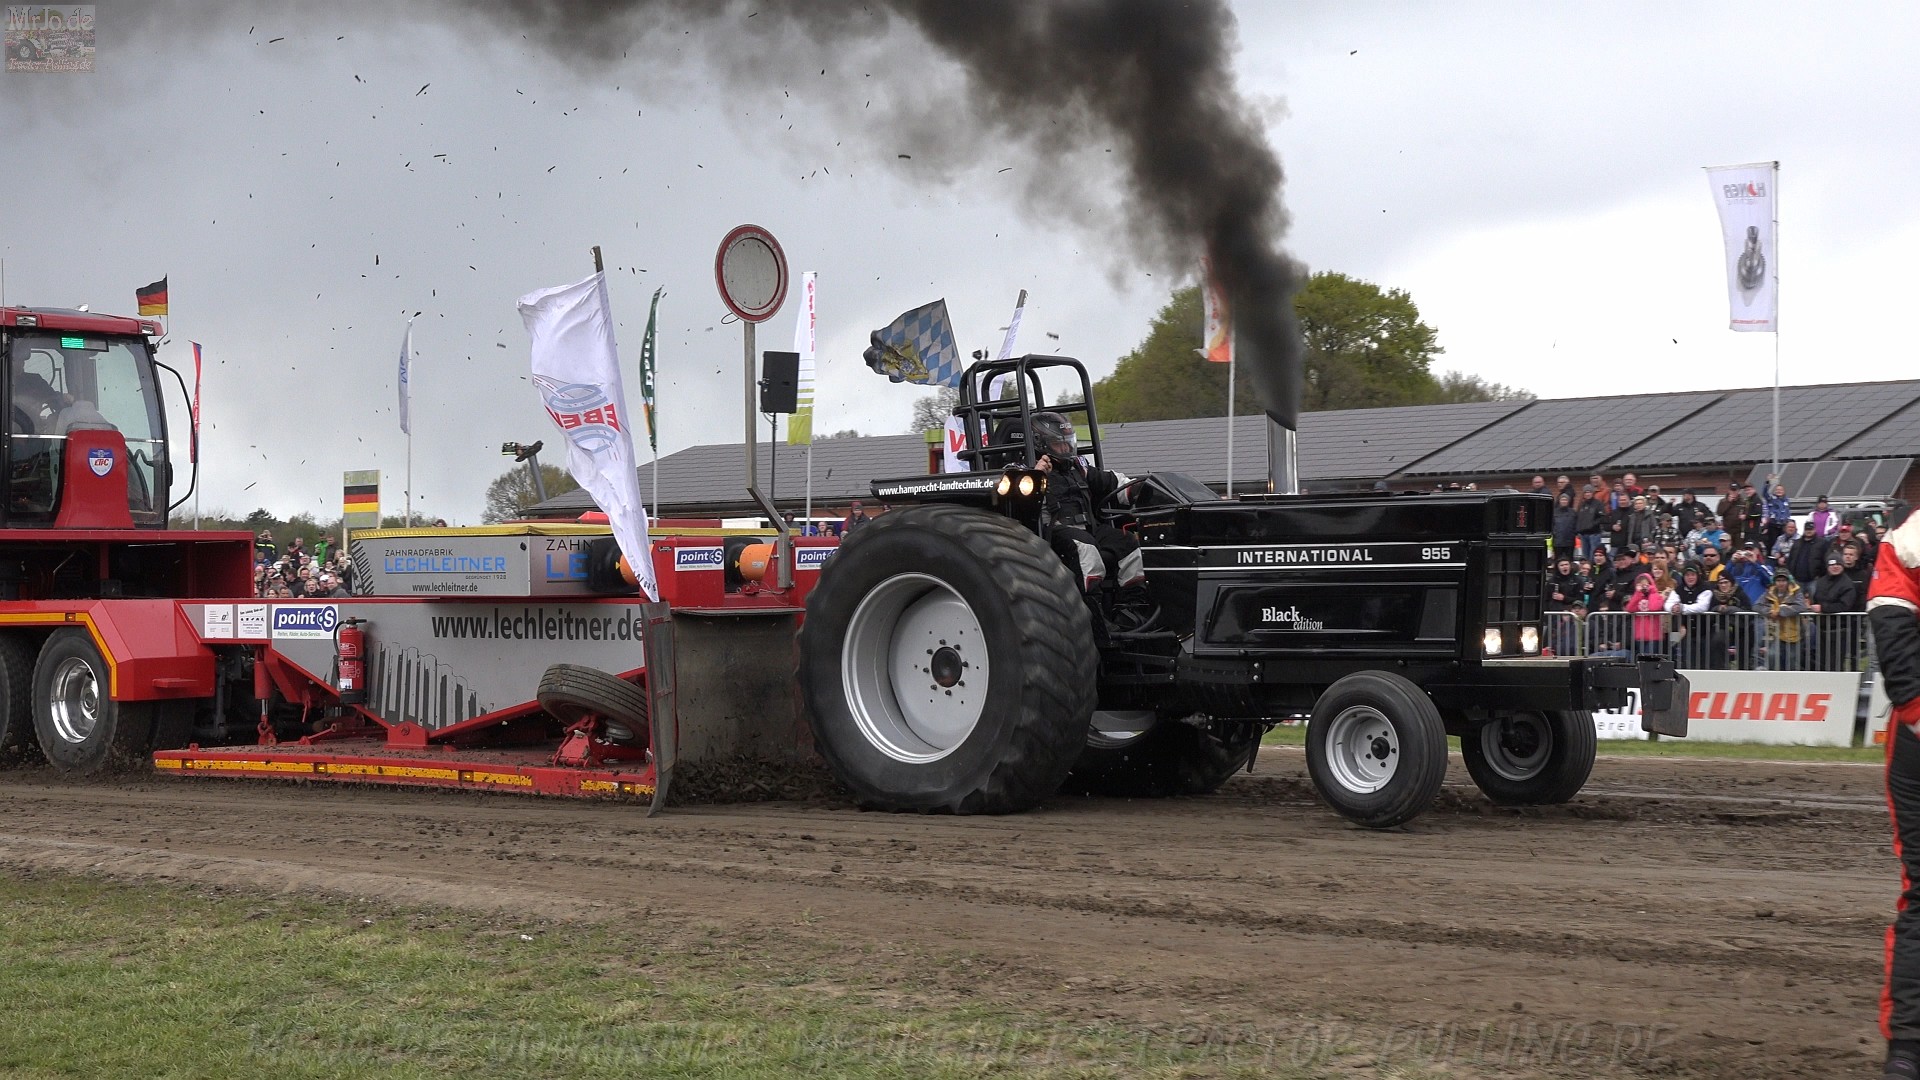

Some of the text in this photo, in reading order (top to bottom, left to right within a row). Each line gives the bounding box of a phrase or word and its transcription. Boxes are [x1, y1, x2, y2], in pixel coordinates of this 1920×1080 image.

[878, 479, 994, 496] www.hamprecht-landtechnik.de
[384, 548, 454, 557] ZAHNRADFABRIK
[680, 552, 709, 563] point
[800, 552, 827, 563] point
[1237, 547, 1451, 564] INTERNATIONAL 955
[384, 557, 507, 572] LECHLEITNER
[412, 581, 478, 593] www.lechleitner.de
[278, 610, 316, 628] point
[1262, 605, 1300, 622] Black
[431, 607, 643, 641] www.lechleitner.de
[1293, 617, 1323, 631] edition
[1688, 692, 1832, 722] CLAAS
